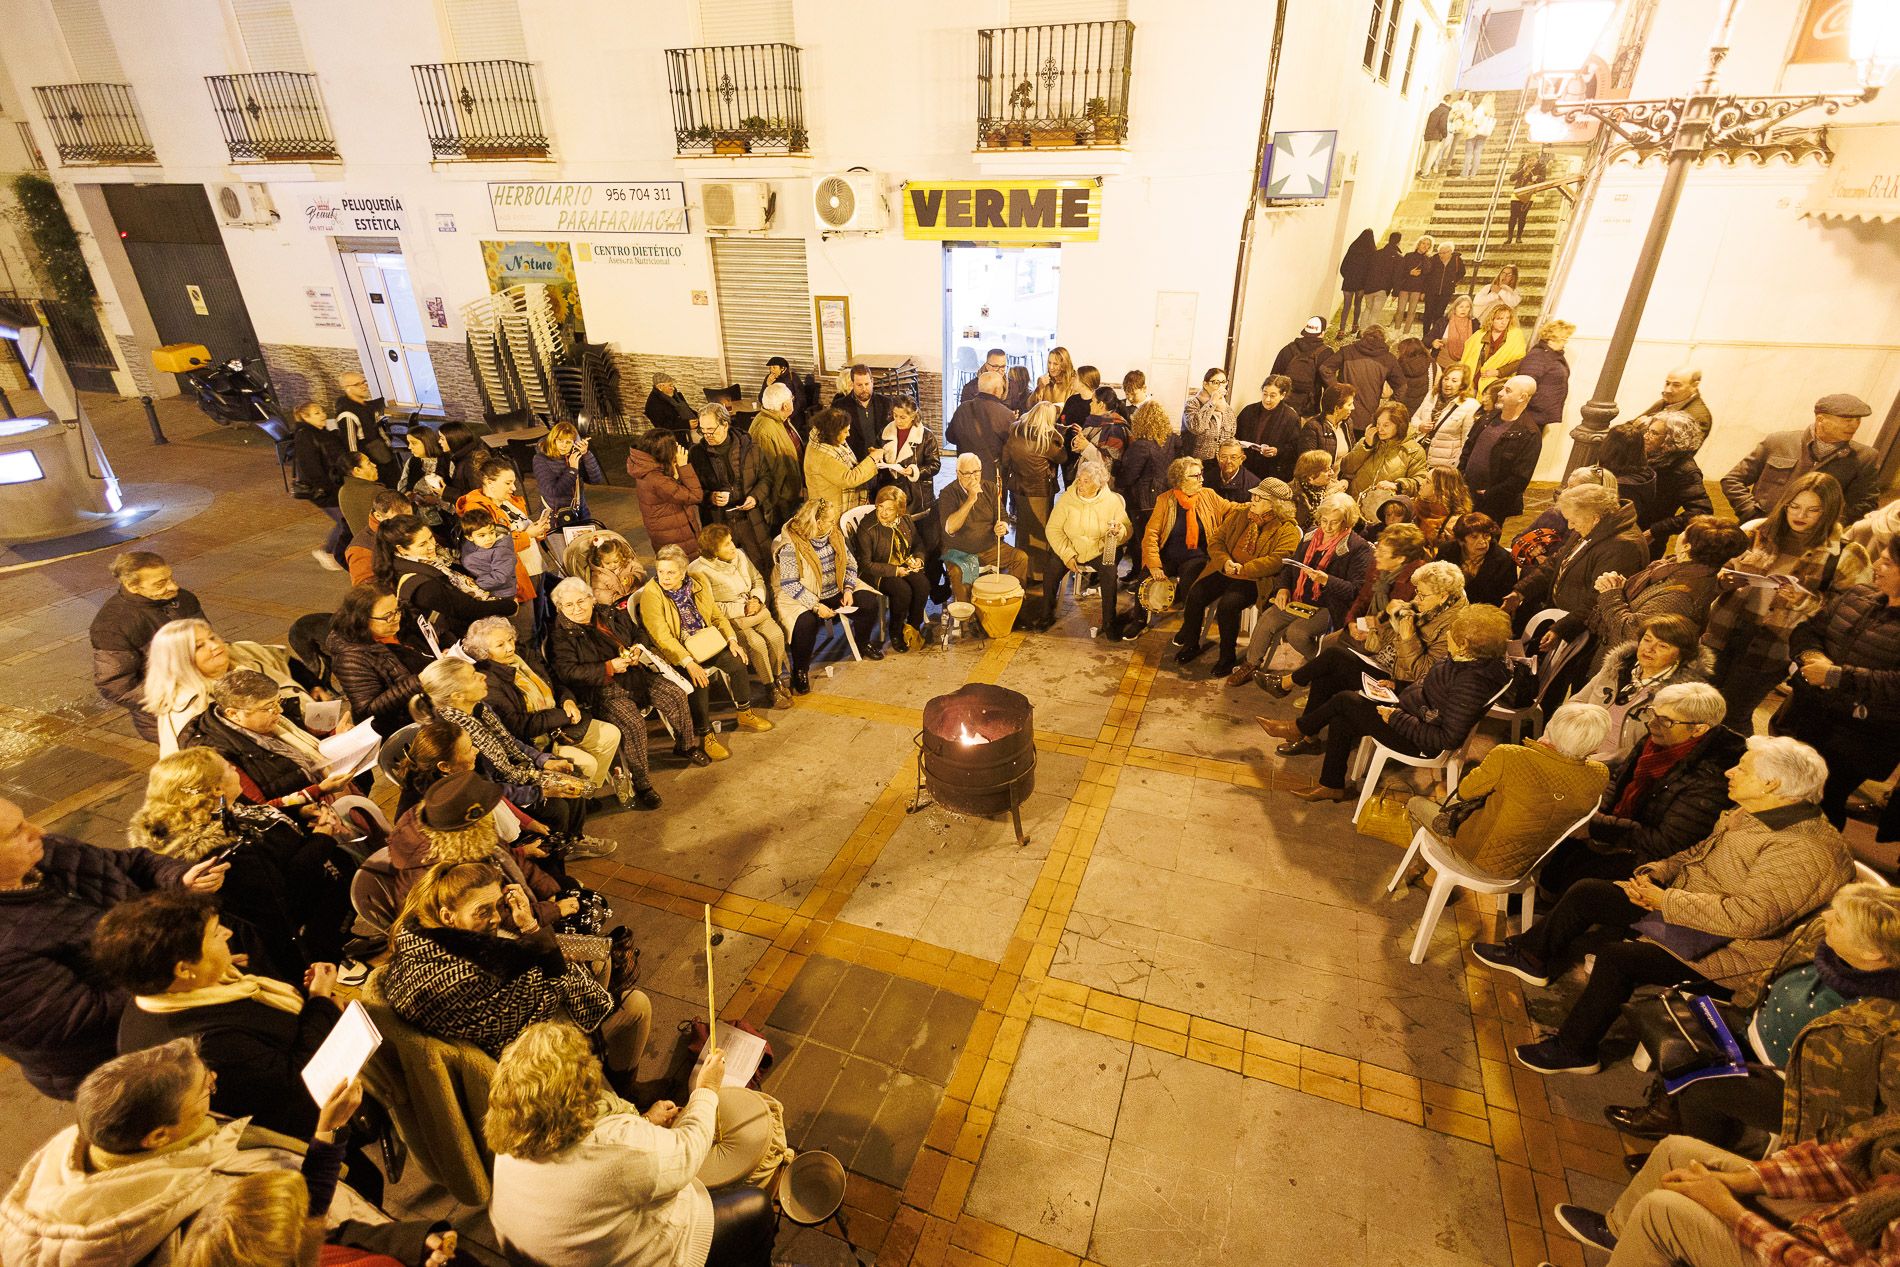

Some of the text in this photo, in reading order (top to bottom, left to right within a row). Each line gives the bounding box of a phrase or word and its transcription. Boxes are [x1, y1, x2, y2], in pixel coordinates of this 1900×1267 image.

[494, 185, 592, 206] HERBOLARIO
[605, 188, 671, 201] 956 704 311
[341, 196, 404, 214] PELUQUERÍA
[909, 188, 1090, 228] VERME
[354, 216, 401, 231] ESTÉTICA
[594, 244, 682, 257] CENTRO DIETÉTICO
[635, 256, 670, 265] Nutricional
